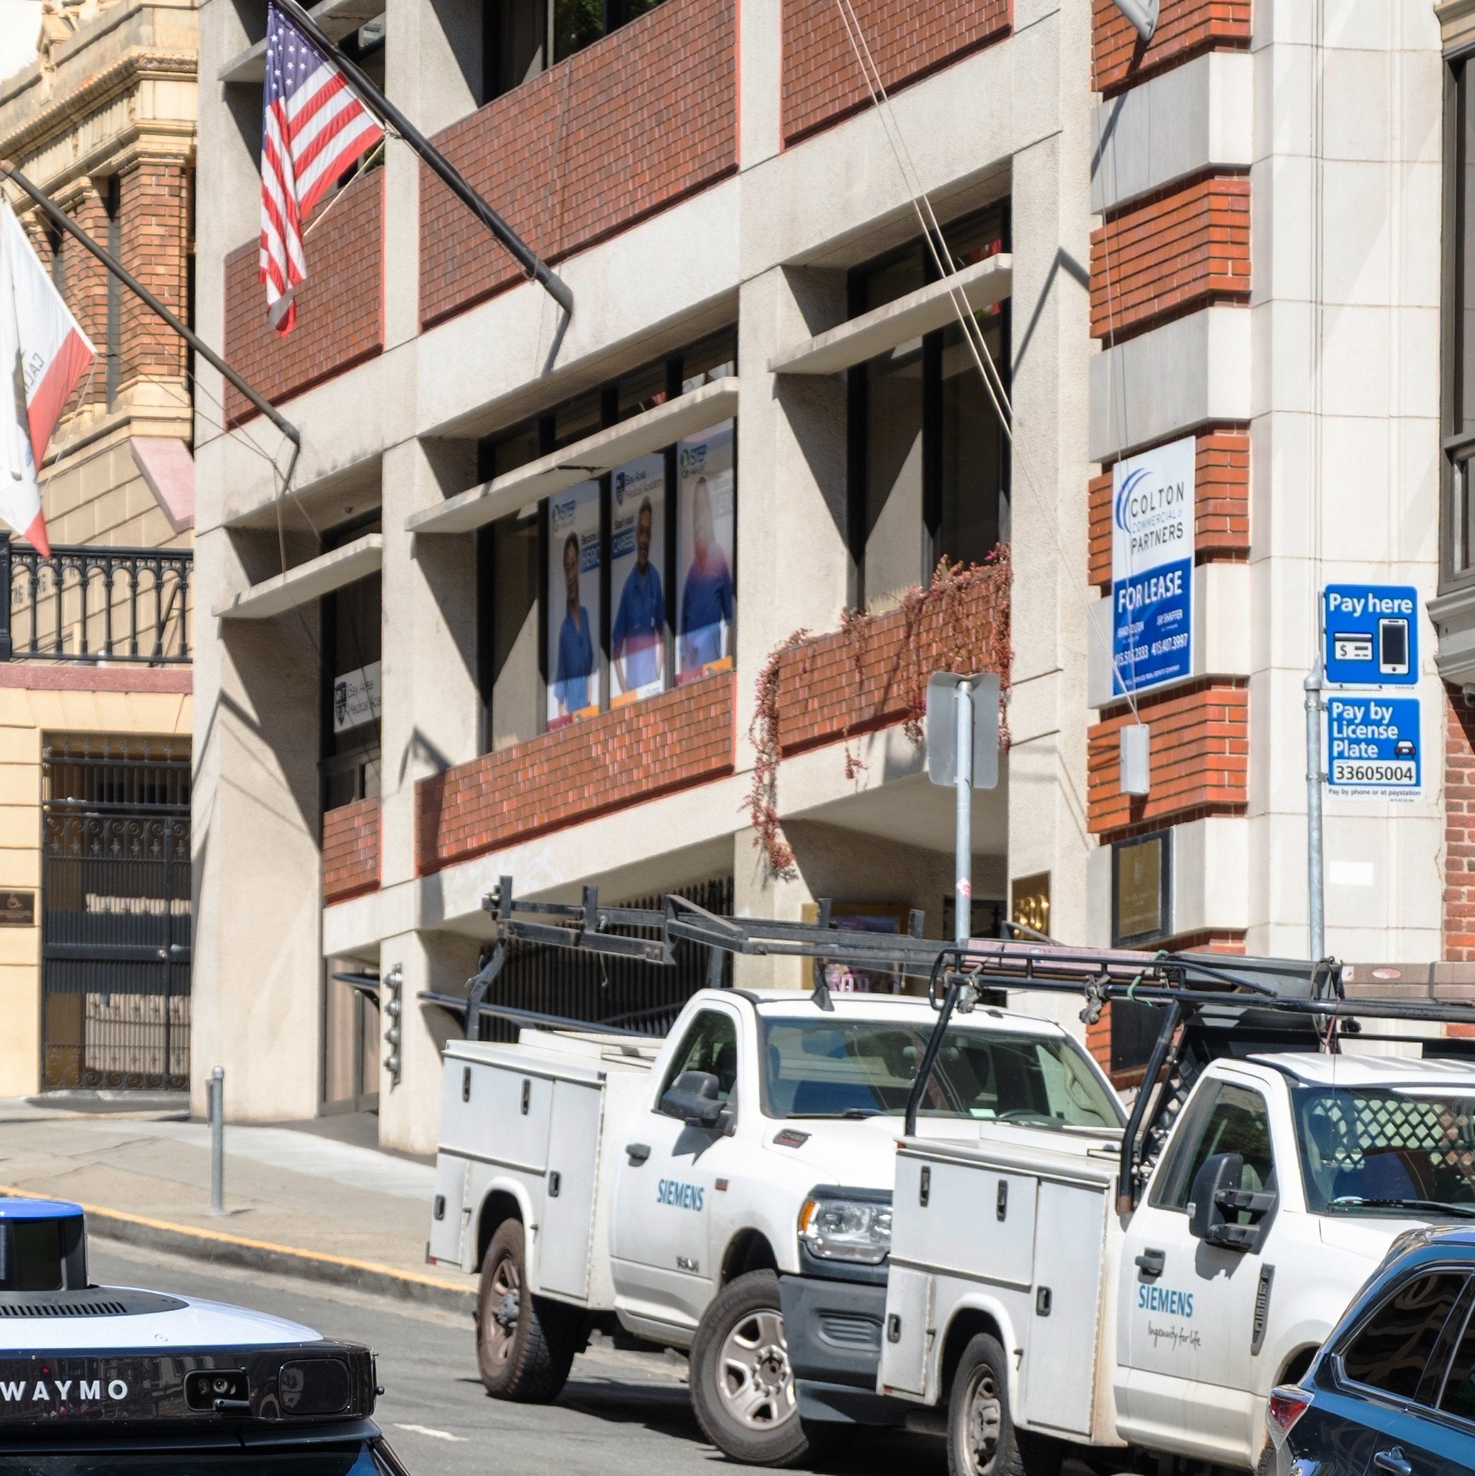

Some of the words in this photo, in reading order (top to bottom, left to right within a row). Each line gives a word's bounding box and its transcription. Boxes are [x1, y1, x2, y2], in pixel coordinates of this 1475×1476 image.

[1131, 481, 1184, 518] COLTON
[1131, 521, 1184, 556] PARTNERS
[1117, 584, 1143, 613] FOR
[1144, 570, 1183, 604] LEASE
[1329, 593, 1365, 617] Pay
[1368, 593, 1413, 614] here
[1332, 702, 1365, 724] Pay
[1370, 701, 1393, 724] by
[1333, 720, 1398, 739] License
[1333, 740, 1379, 758] Plate
[1336, 765, 1413, 781] 33605004
[1328, 788, 1340, 796] Pay
[1341, 788, 1349, 796] by
[1351, 788, 1371, 796] phone
[1388, 789, 1422, 798] paystation
[656, 1178, 705, 1212] SIEMENS
[1138, 1283, 1194, 1319] SIEMENS
[1148, 1320, 1178, 1352] Ingenuity
[1189, 1329, 1202, 1351] life
